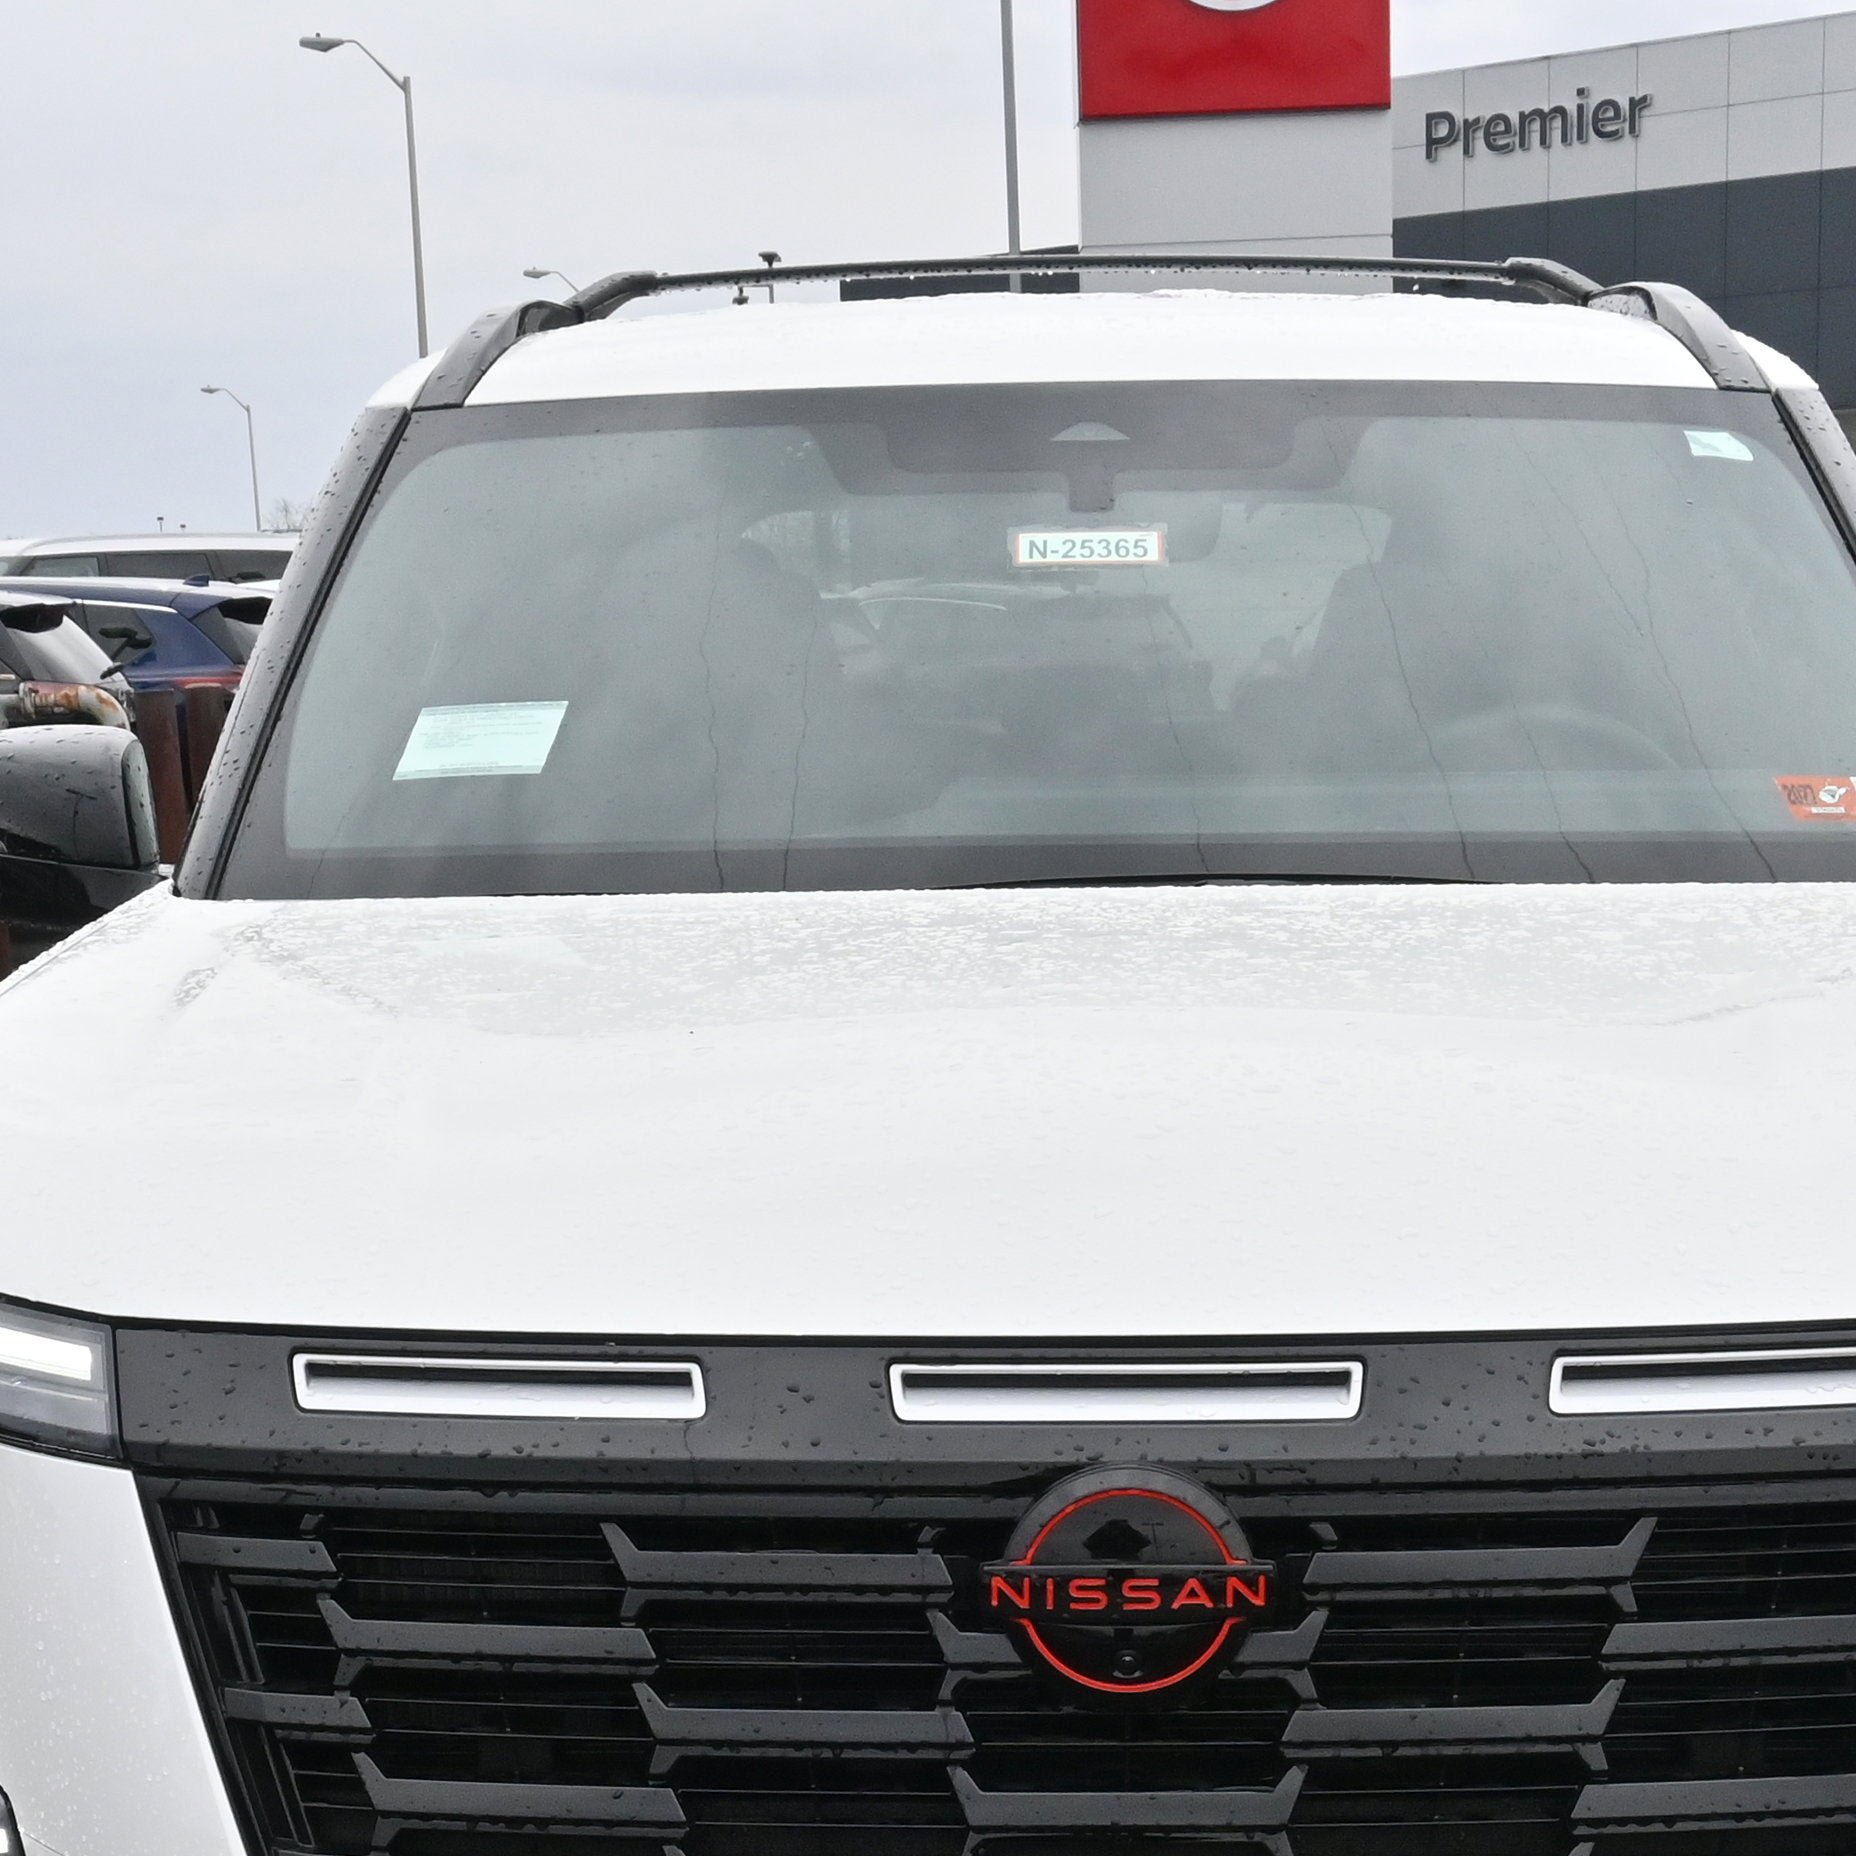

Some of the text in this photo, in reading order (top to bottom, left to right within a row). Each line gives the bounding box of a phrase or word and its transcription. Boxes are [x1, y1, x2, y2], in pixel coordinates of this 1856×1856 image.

[1425, 86, 1652, 162] Premier
[1028, 538, 1148, 559] N-25365
[990, 1575, 1266, 1611] NISSAN
